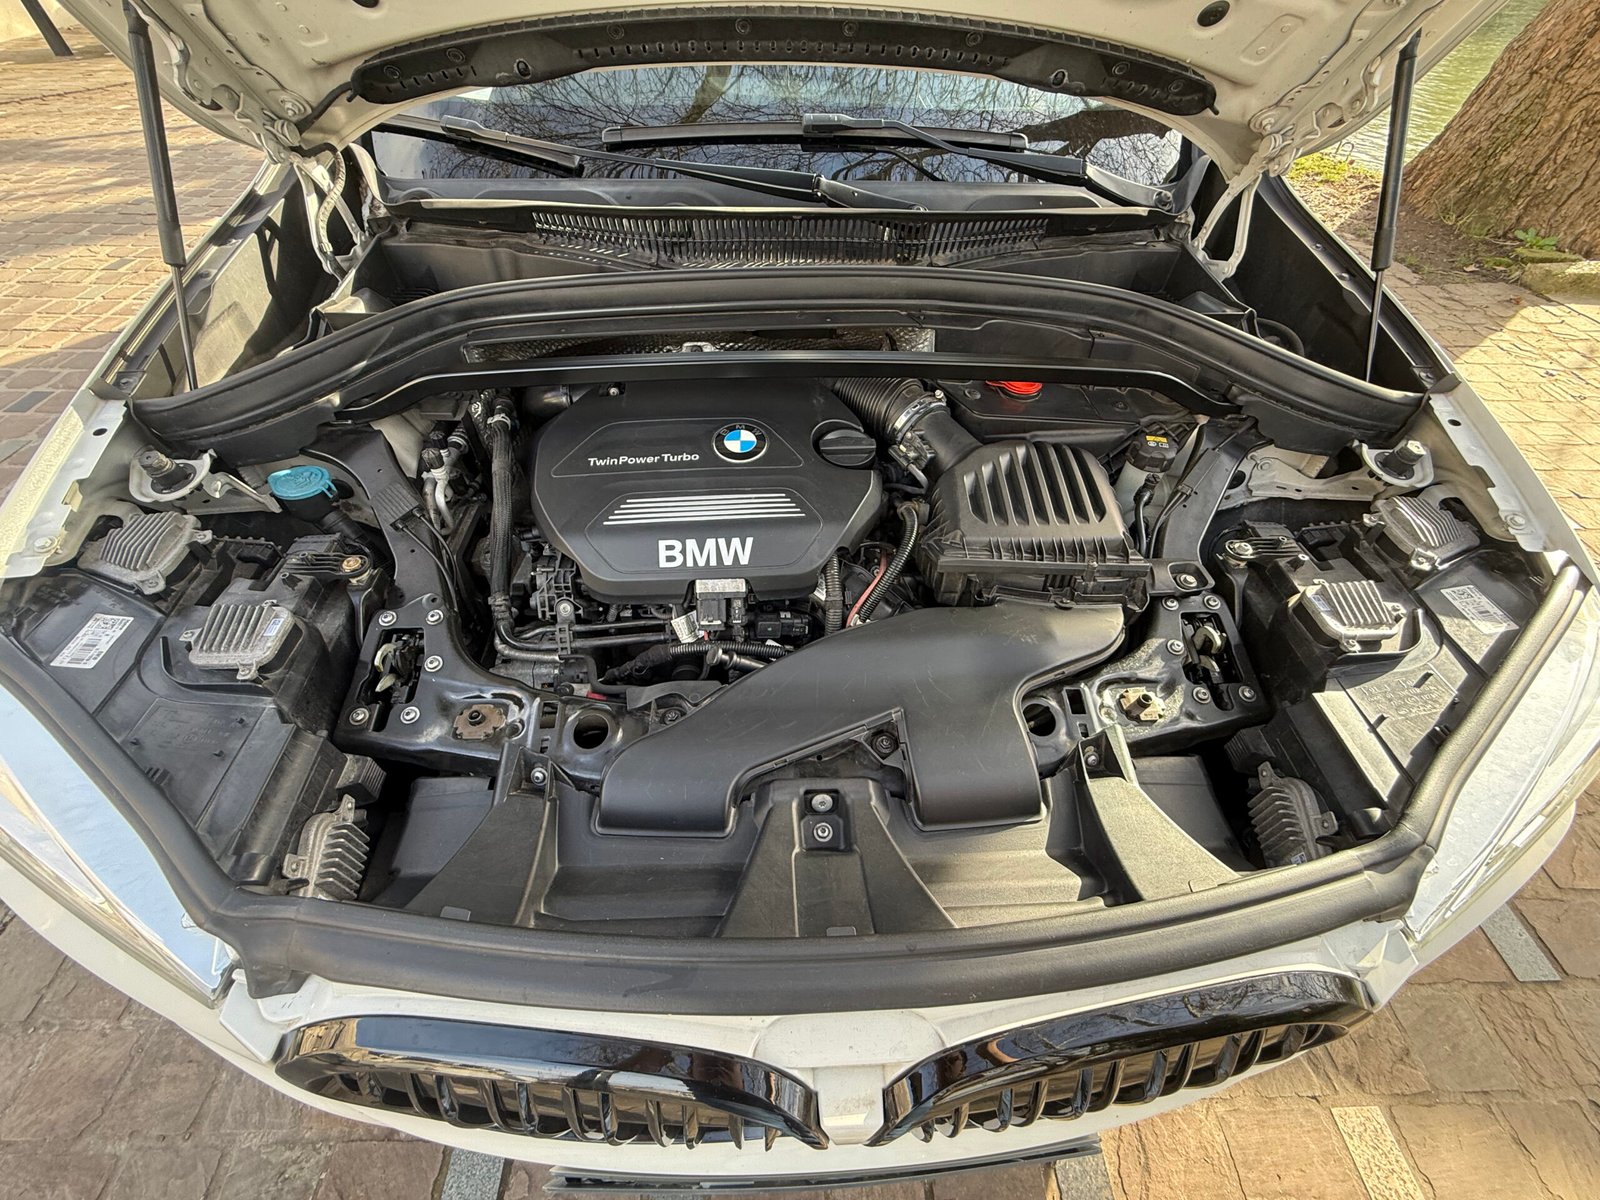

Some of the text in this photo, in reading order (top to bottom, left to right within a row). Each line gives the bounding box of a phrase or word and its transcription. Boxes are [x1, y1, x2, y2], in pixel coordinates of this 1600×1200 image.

[720, 424, 762, 436] BMW
[661, 453, 700, 462] Turbo
[658, 537, 754, 568] BMW
